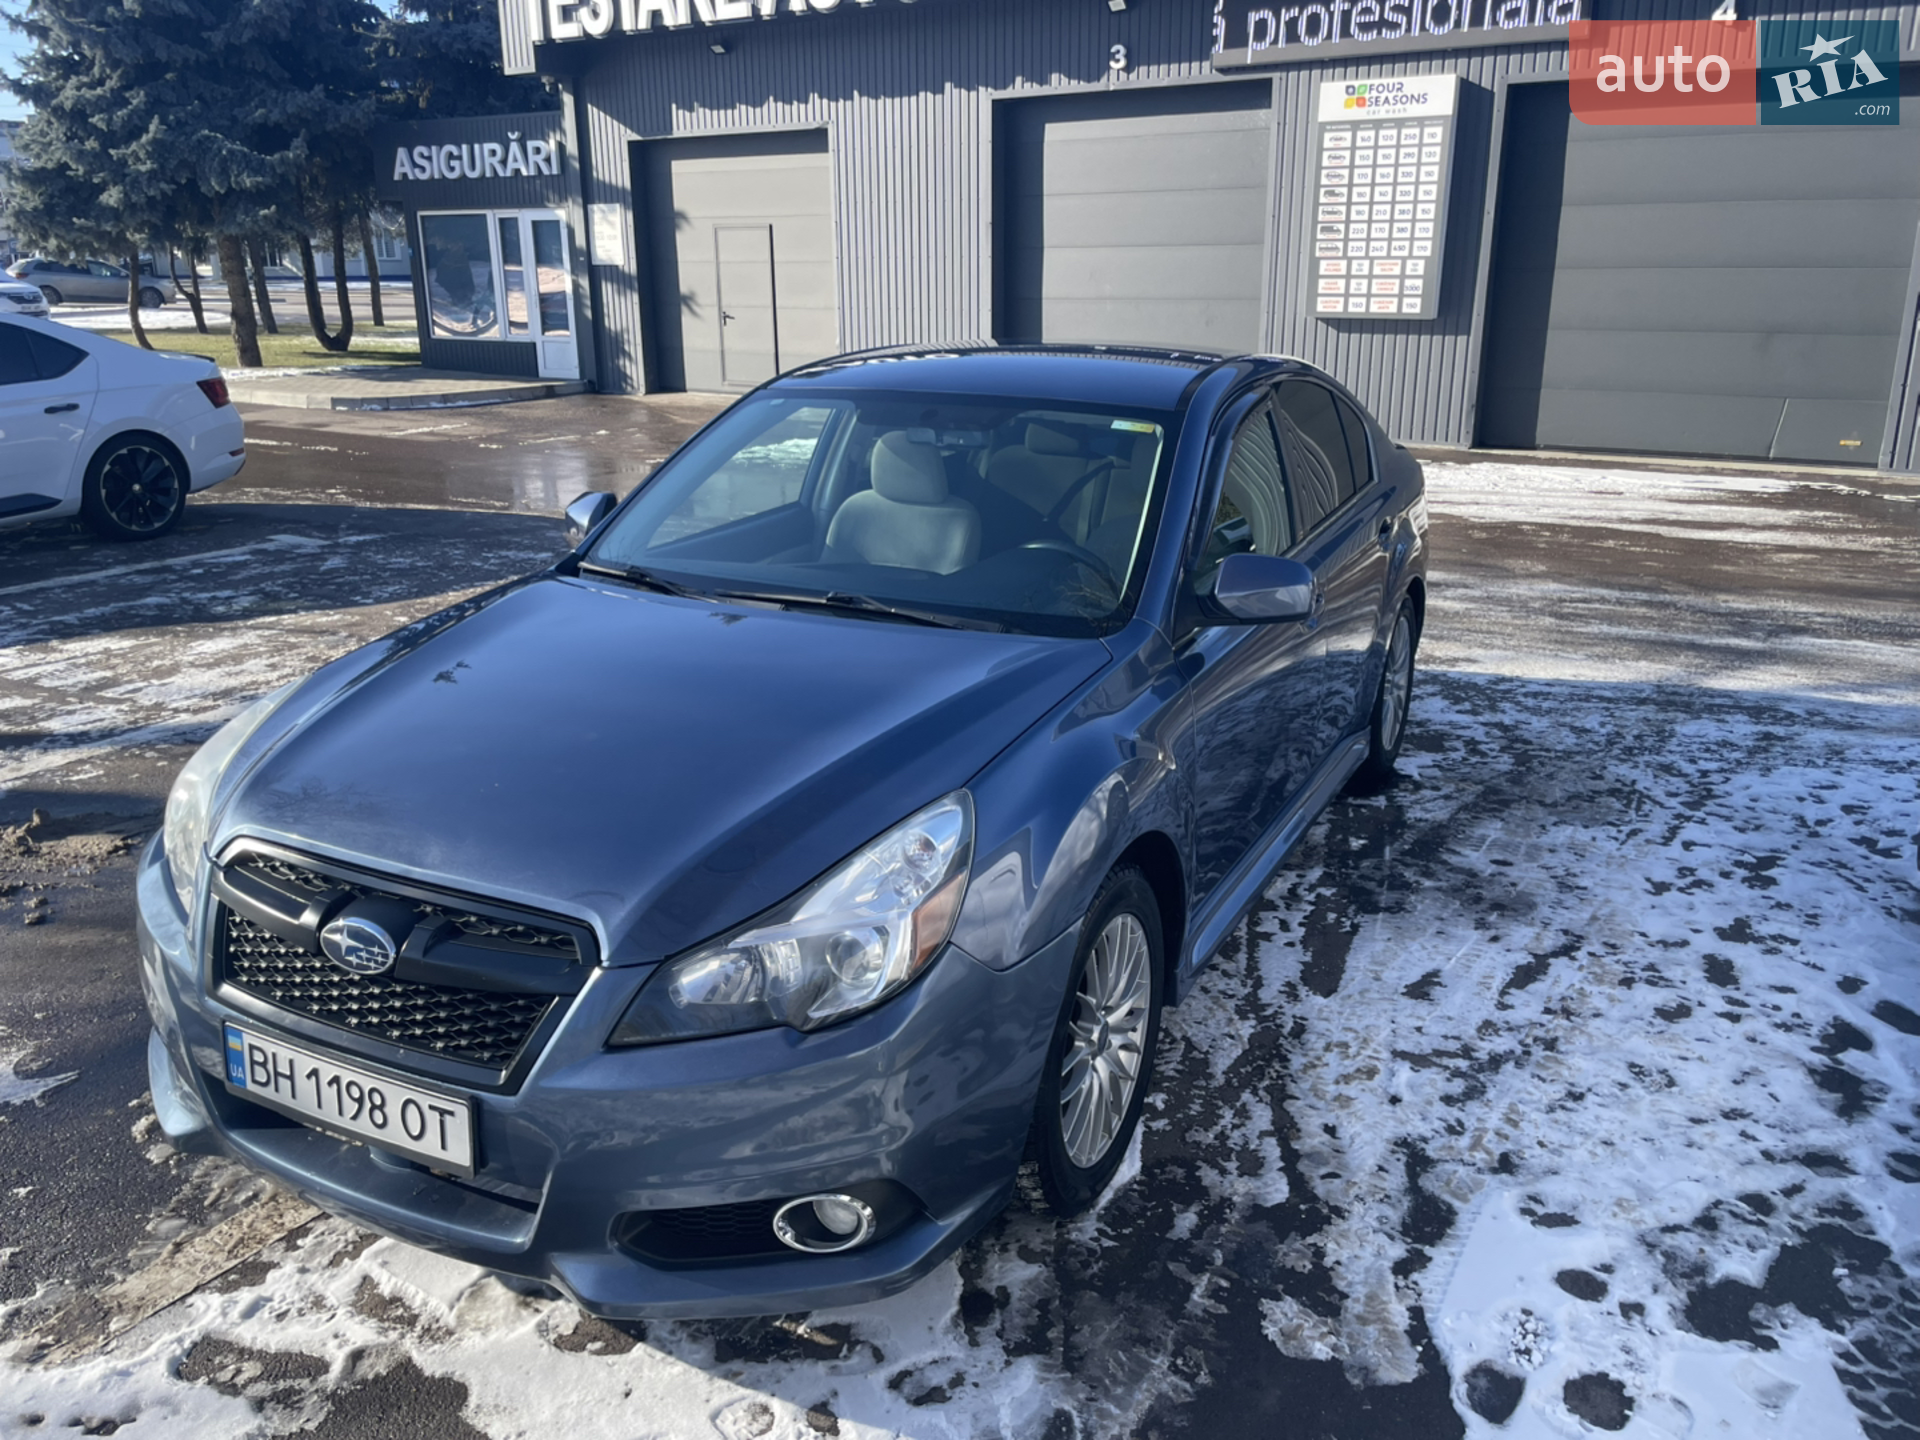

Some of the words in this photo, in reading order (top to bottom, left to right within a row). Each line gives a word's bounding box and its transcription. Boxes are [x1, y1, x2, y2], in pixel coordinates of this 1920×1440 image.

[1109, 44, 1127, 70] 3
[1368, 82, 1404, 95] FOUR
[1367, 93, 1428, 107] SEASONS
[393, 131, 561, 181] ASIGURĂRI
[230, 1063, 245, 1080] UA
[248, 1042, 297, 1101] BH
[305, 1067, 388, 1130] 1198
[400, 1097, 455, 1151] OT
